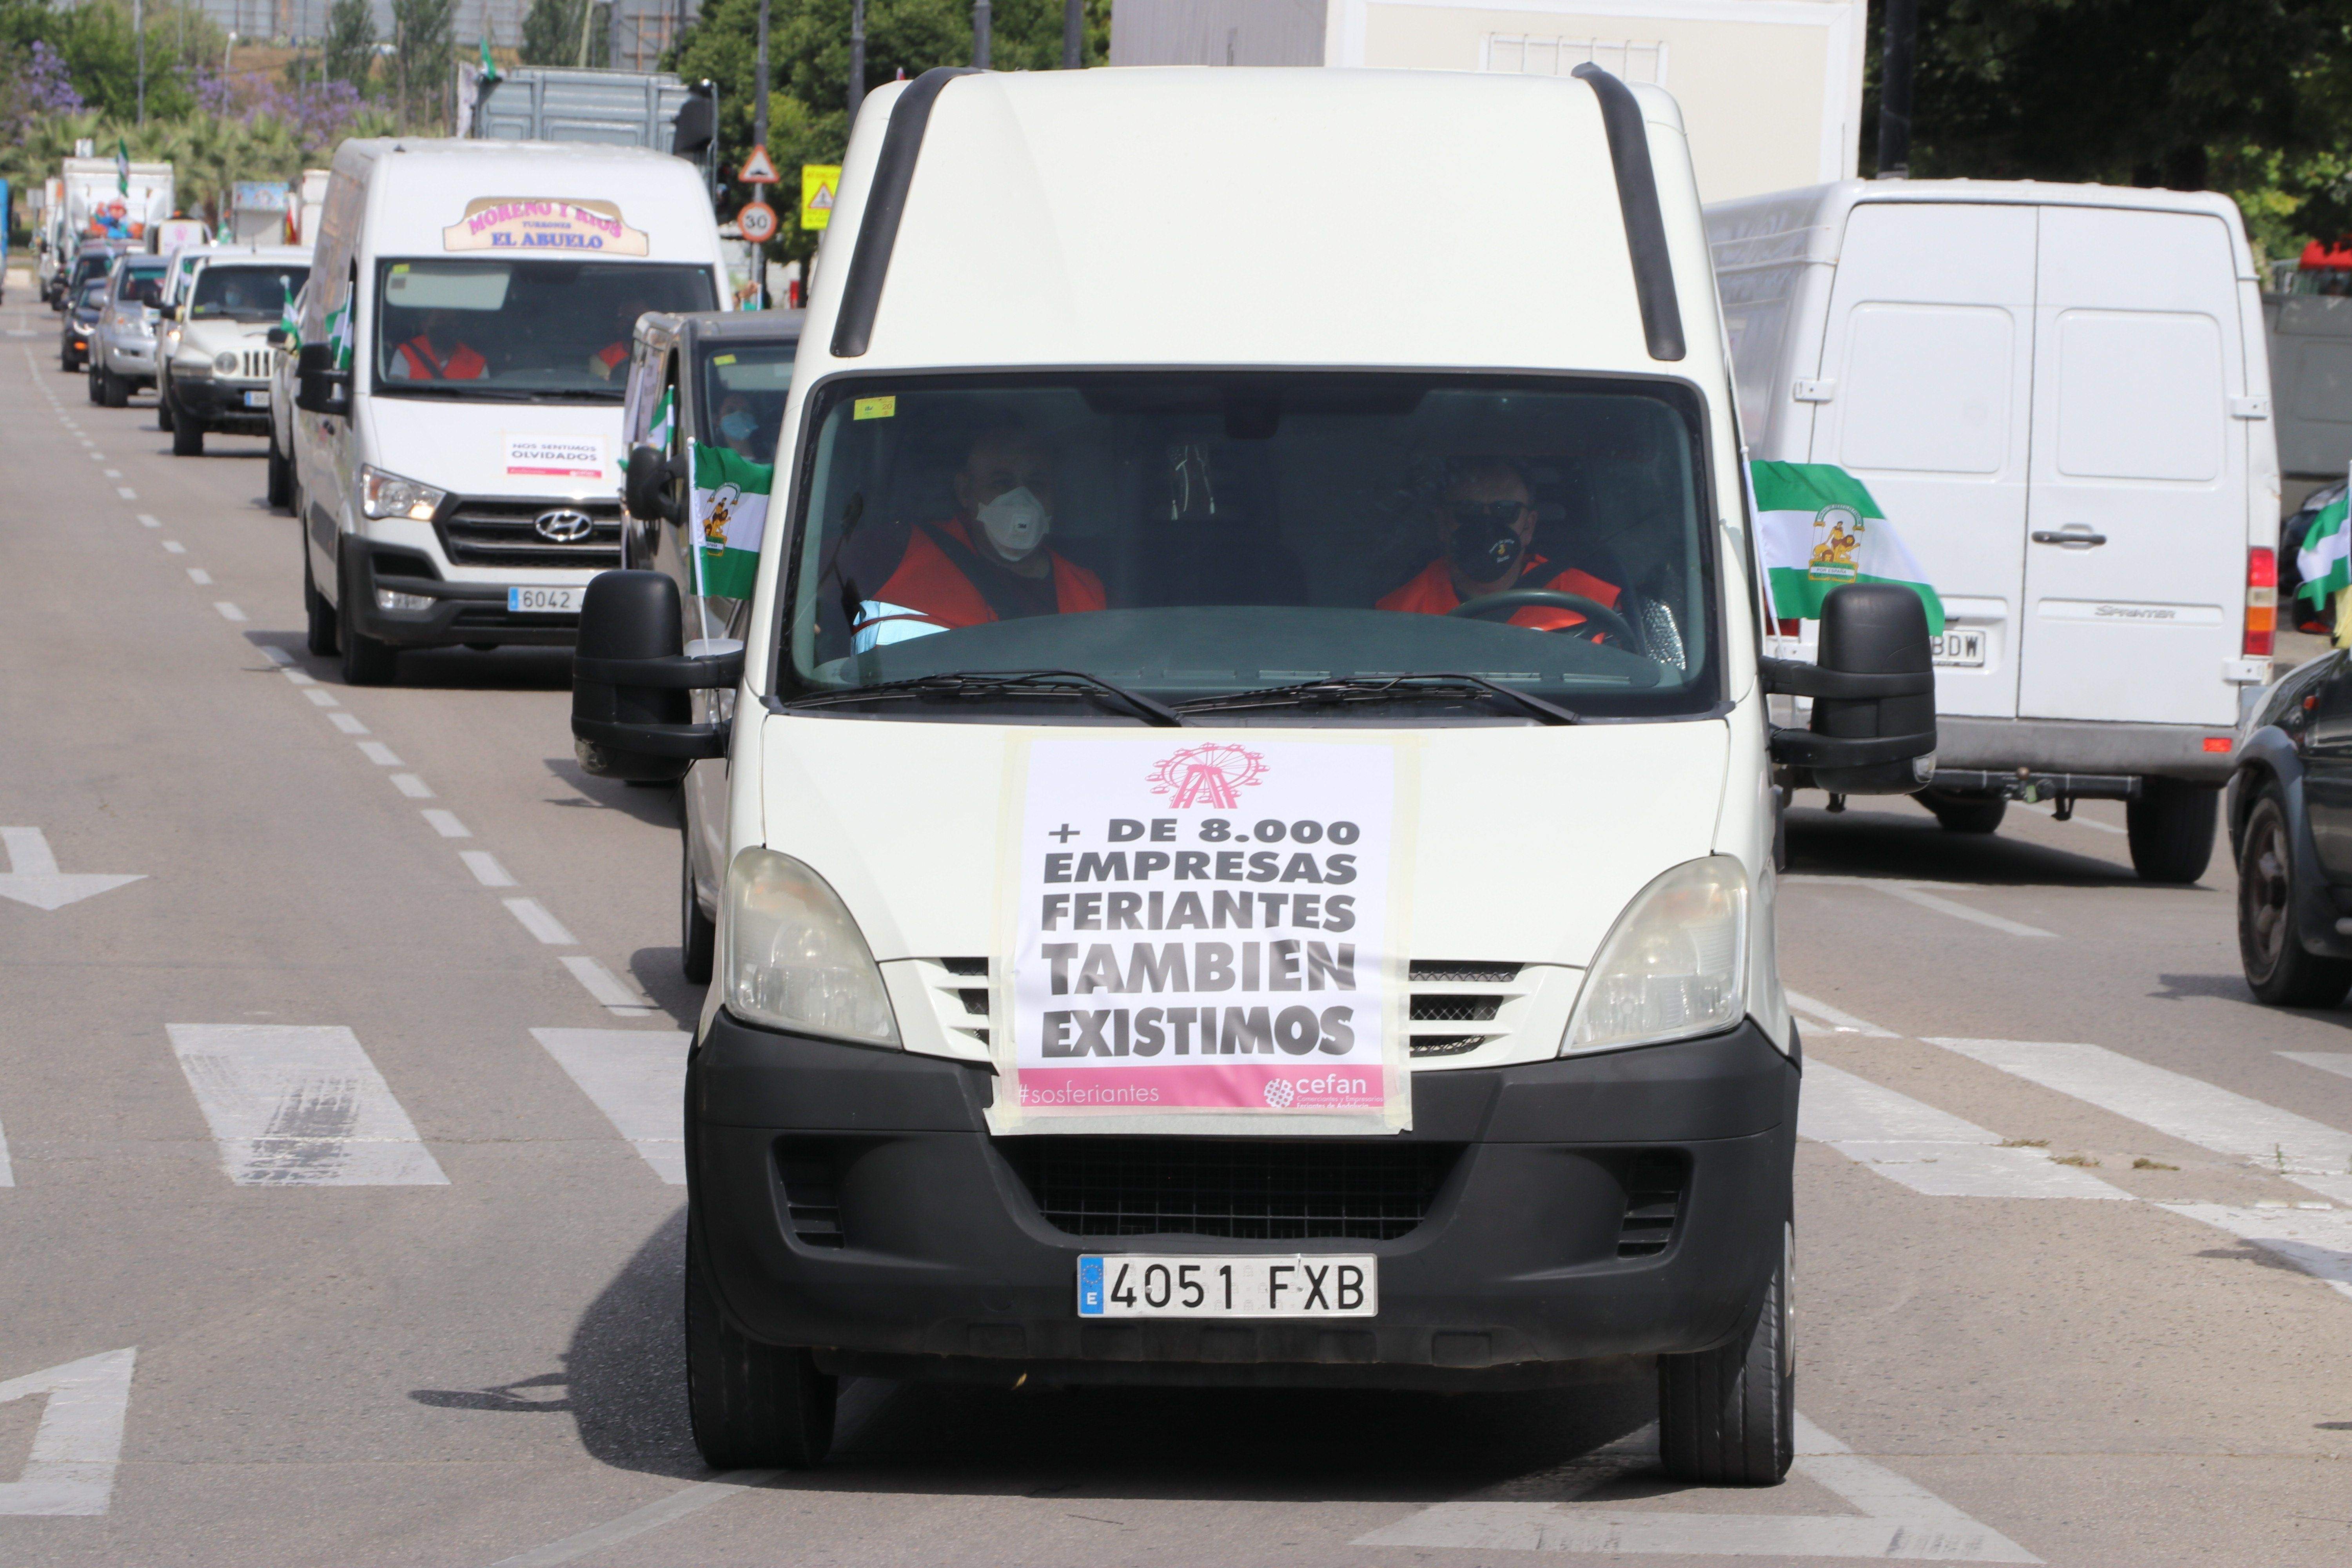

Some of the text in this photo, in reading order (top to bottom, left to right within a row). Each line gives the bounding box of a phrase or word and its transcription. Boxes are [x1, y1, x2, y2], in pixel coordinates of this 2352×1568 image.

[746, 214, 767, 228] 30
[492, 232, 604, 249] EL ABUELO
[512, 450, 597, 461] OLVIDADOS
[523, 590, 570, 608] 6042
[1108, 818, 1177, 842] DE
[1198, 818, 1360, 846] 8.000
[1044, 851, 1357, 885] EMPRESAS
[1041, 890, 1356, 933] FERIANTES
[1041, 939, 1356, 996] TAMBIEN
[1041, 1005, 1355, 1058] EXISTIMOS
[1019, 1080, 1159, 1103] #sosferiantes
[1296, 1073, 1367, 1094] cefan
[1111, 1263, 1364, 1310] 4051 FXB
[1086, 1292, 1097, 1305] E
